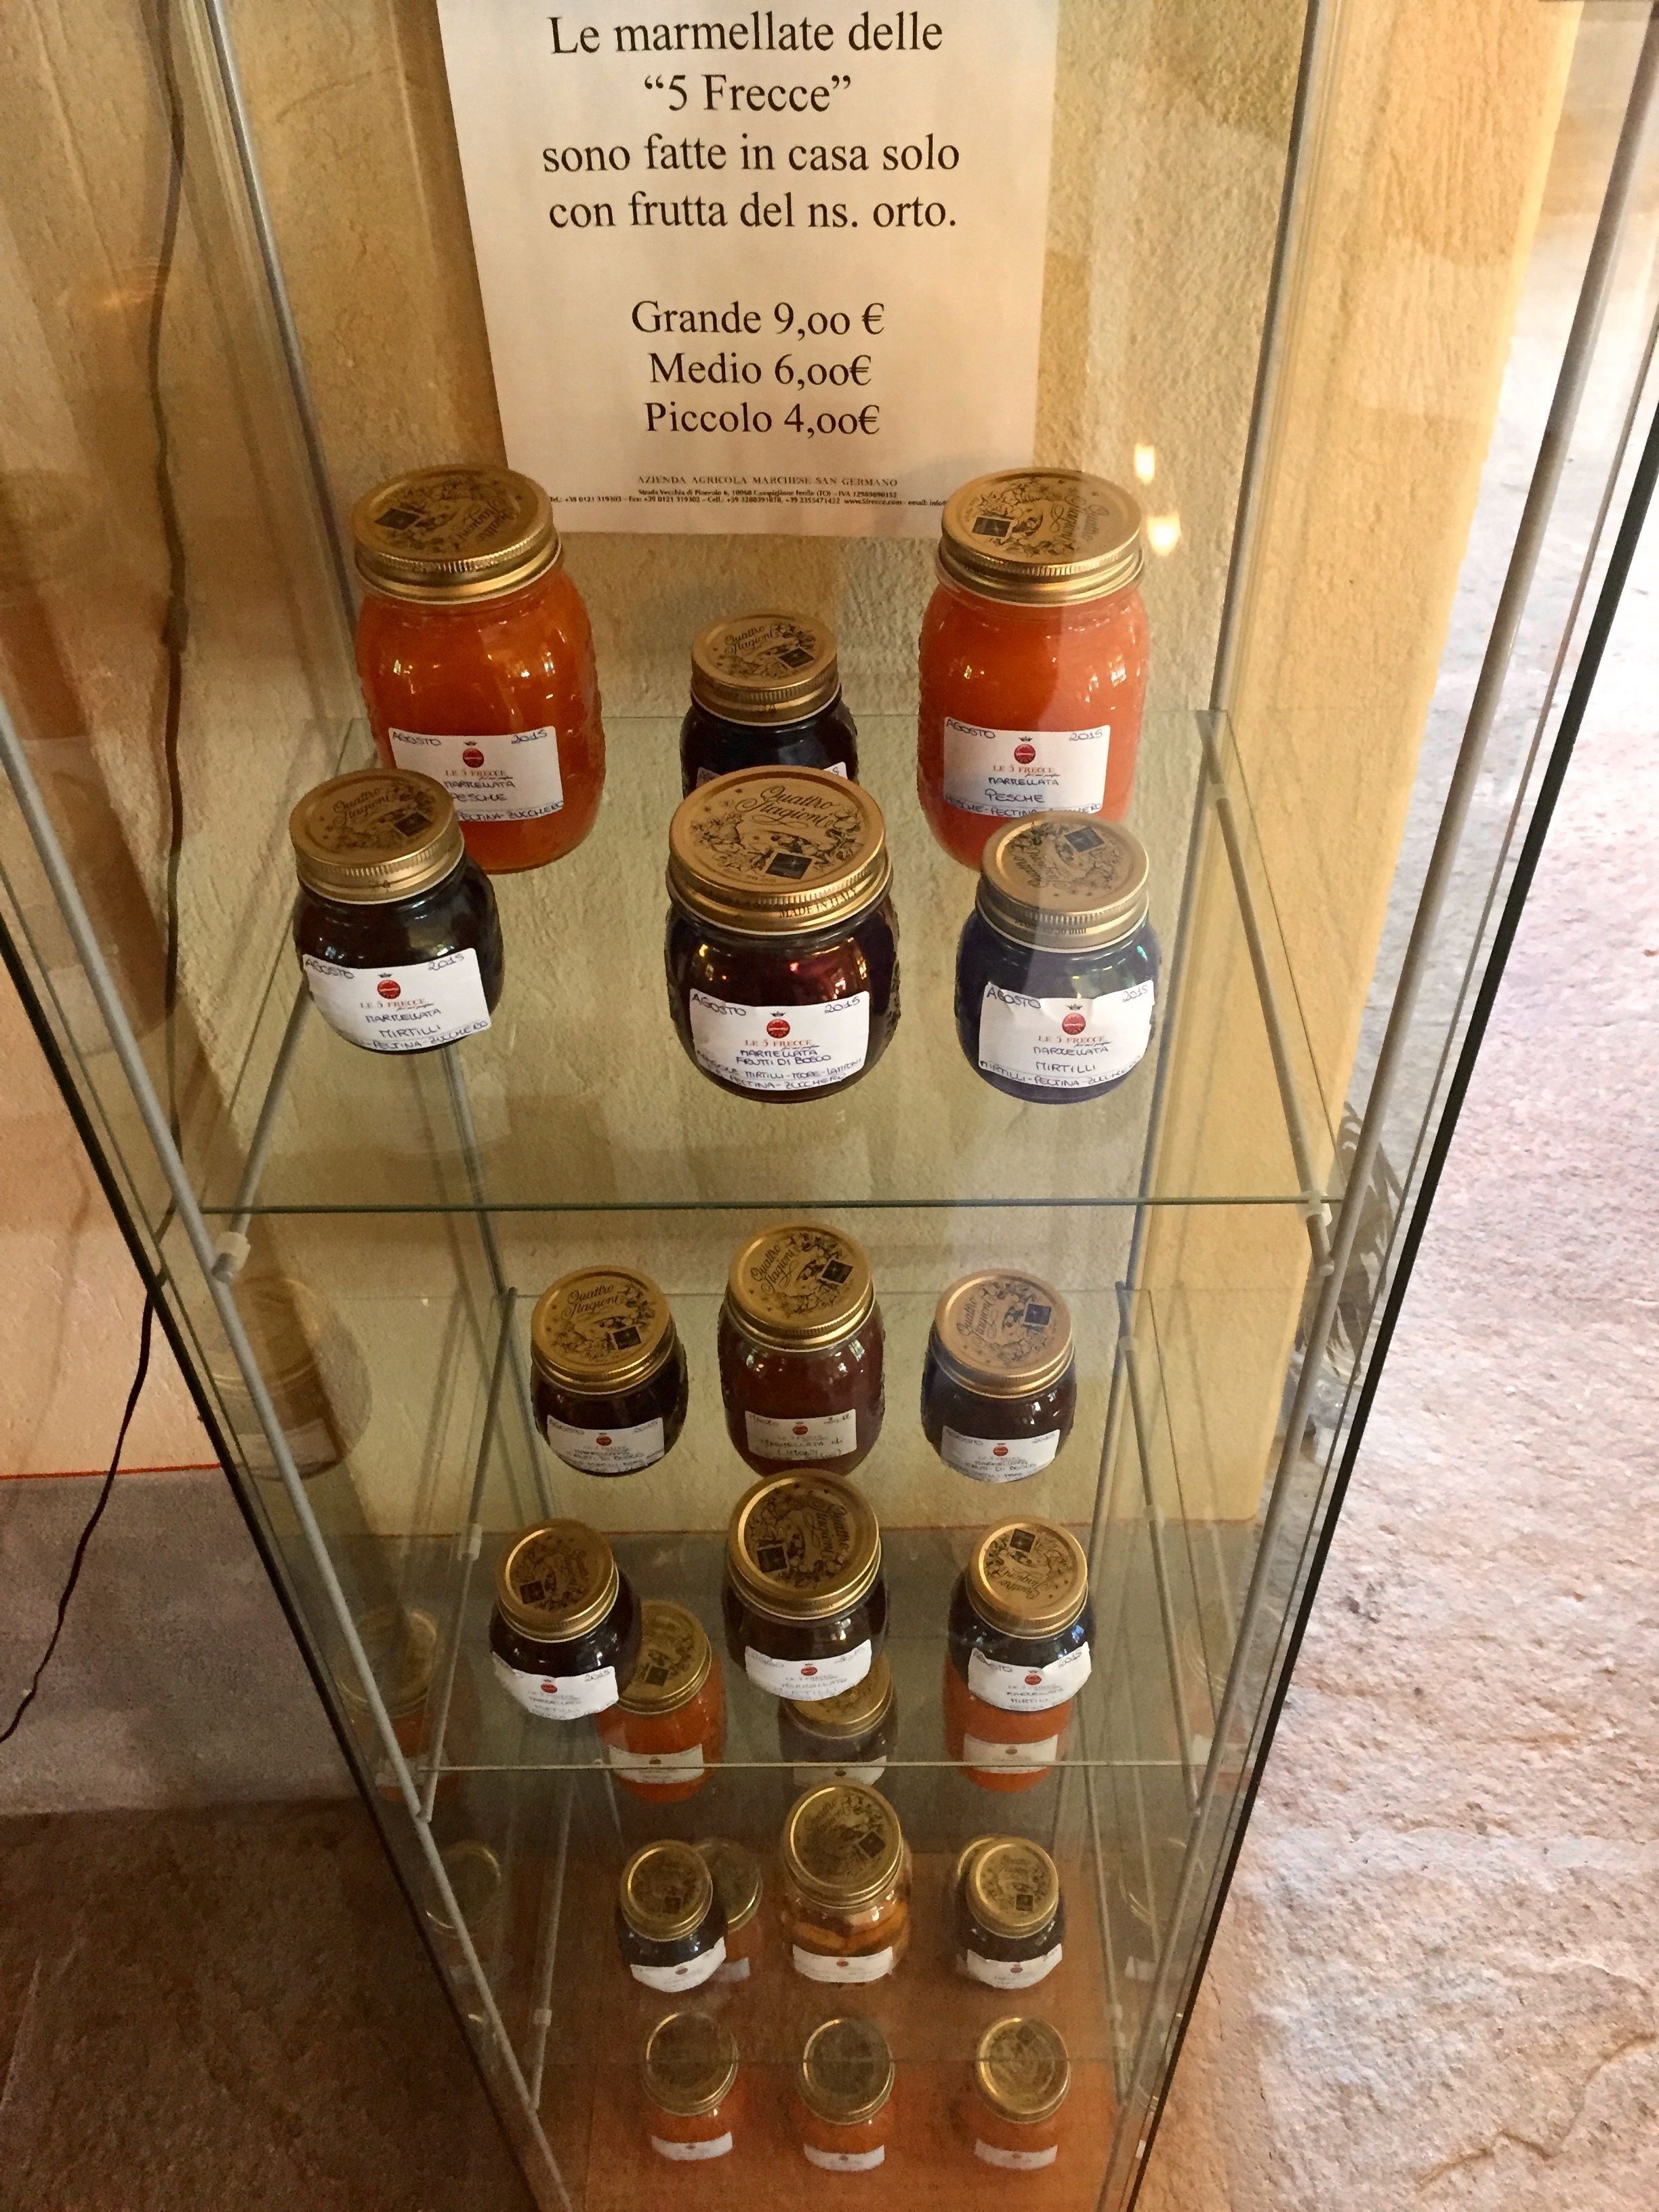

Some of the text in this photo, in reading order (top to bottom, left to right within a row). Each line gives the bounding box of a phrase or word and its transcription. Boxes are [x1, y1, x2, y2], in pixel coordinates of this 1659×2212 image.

[550, 11, 942, 54] Le marmellate delle
[543, 134, 959, 172] sono fatte in casa solo
[550, 191, 955, 228] con frutta del ns. orto.
[632, 301, 761, 333] Grande
[862, 303, 884, 335] €
[649, 352, 761, 384] Medio
[645, 401, 772, 432] Piccolo
[639, 476, 687, 484] AZIENDA
[752, 476, 811, 485] MARCHESE
[841, 478, 898, 486] GERMANO
[392, 729, 547, 746] AGOSTO 2015
[945, 718, 1103, 741] AGOSTO 2015
[988, 777, 1059, 786] MARMELLATA
[760, 785, 836, 810] Quattro
[985, 788, 1044, 803] PESCHE
[735, 797, 834, 828] Stagioni
[779, 905, 813, 918] MADE
[305, 953, 464, 979] AGOSTO 2015
[691, 992, 861, 1017] AGOSTO 2015
[986, 984, 1148, 1009] AGOSTO 2015
[379, 1024, 442, 1039] MIRTILLI
[773, 1039, 812, 1047] FRECCE
[736, 1054, 832, 1066] FRUTTI DI BOSCO
[740, 1049, 817, 1058] MARMELLATA
[1036, 1061, 1096, 1073] MIRTILLI
